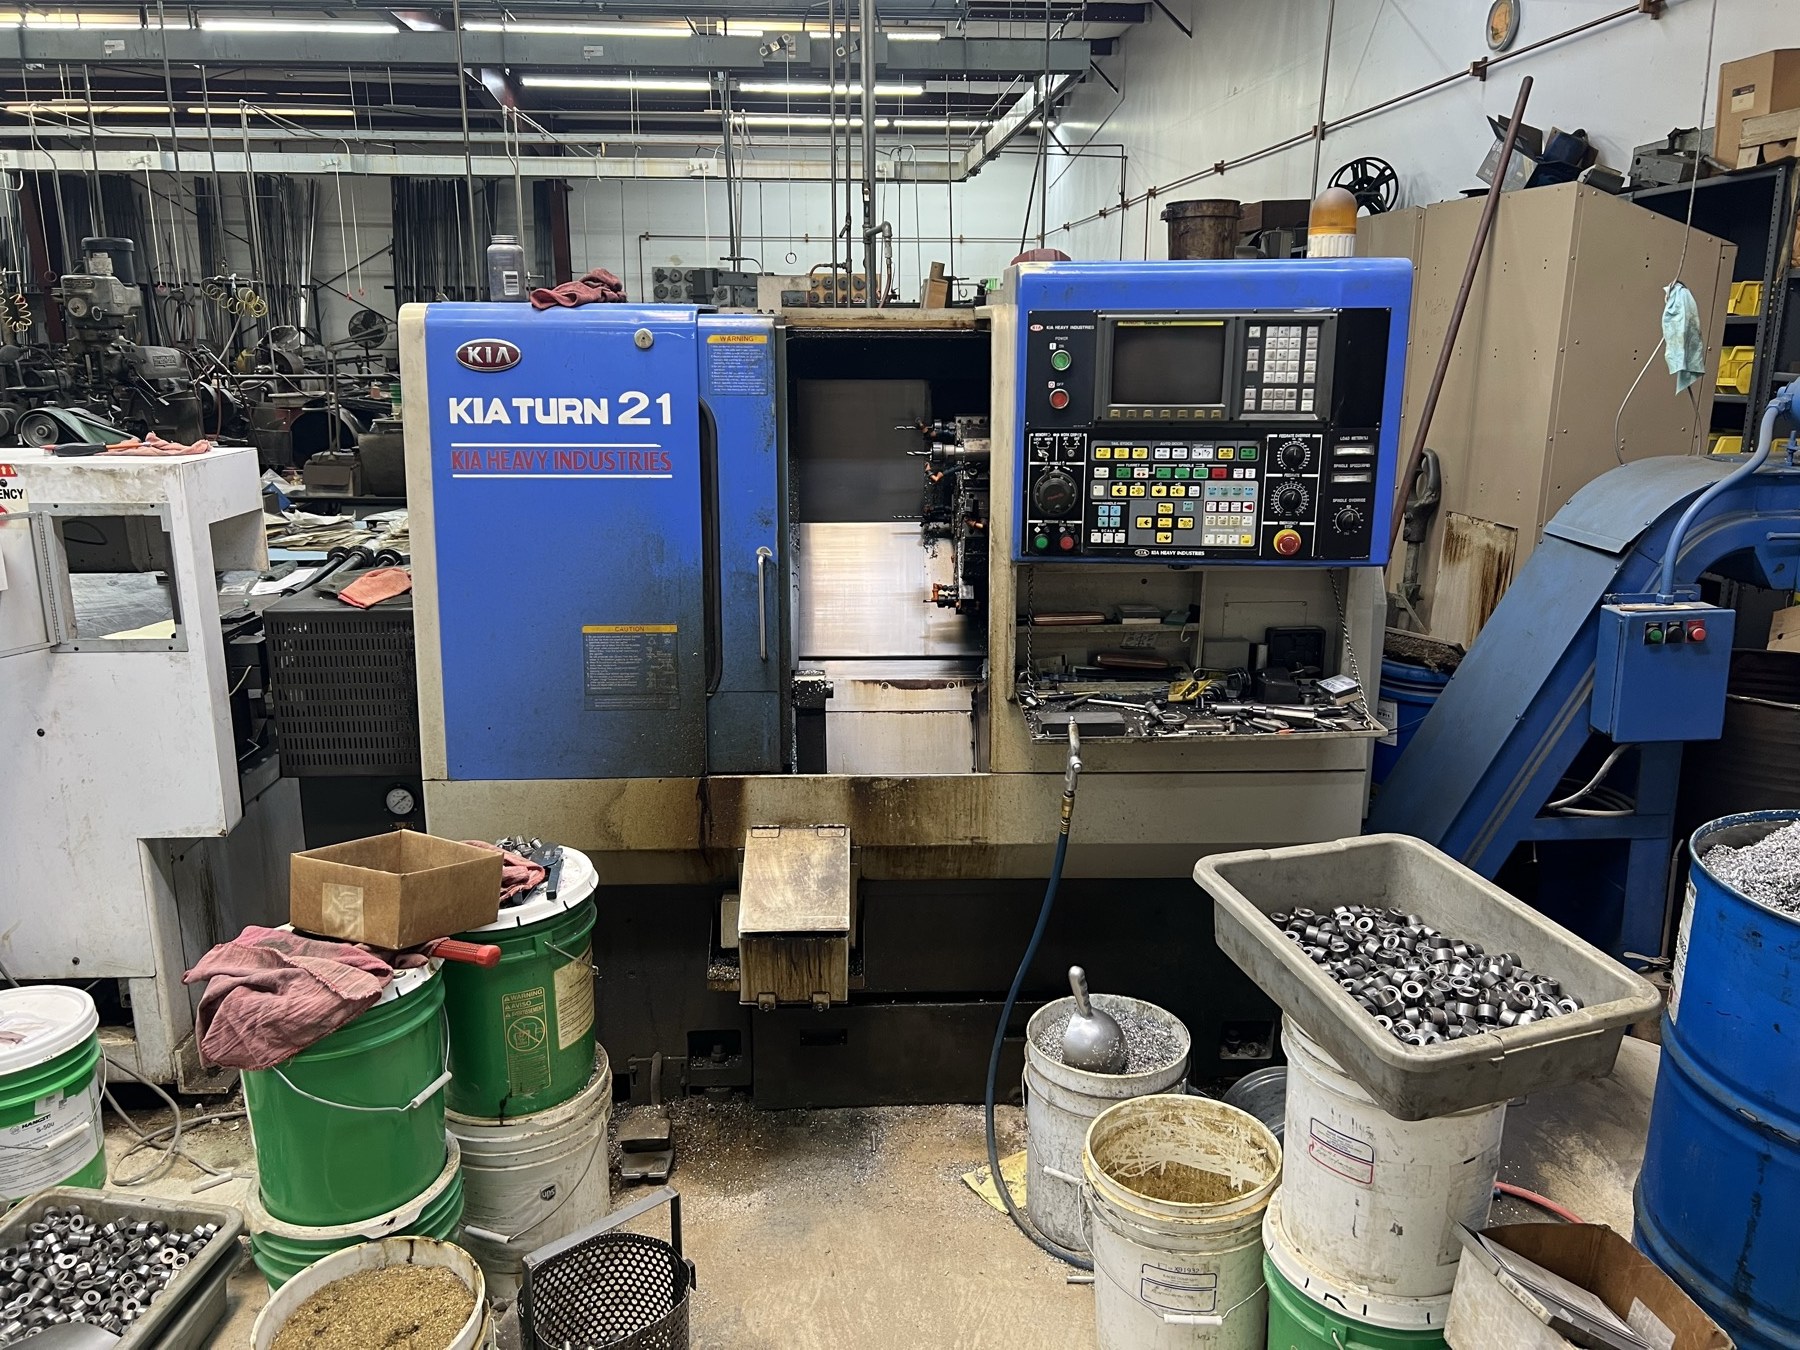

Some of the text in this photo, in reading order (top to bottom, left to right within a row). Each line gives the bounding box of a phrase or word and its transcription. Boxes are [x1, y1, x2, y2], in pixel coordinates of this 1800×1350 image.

[466, 345, 512, 364] KIA
[617, 391, 672, 425] 21
[452, 451, 672, 471] KIA HEAVY INDUSTRIES
[510, 989, 543, 1002] WARNING
[511, 1000, 531, 1010] AVISO
[542, 1189, 555, 1199] ups
